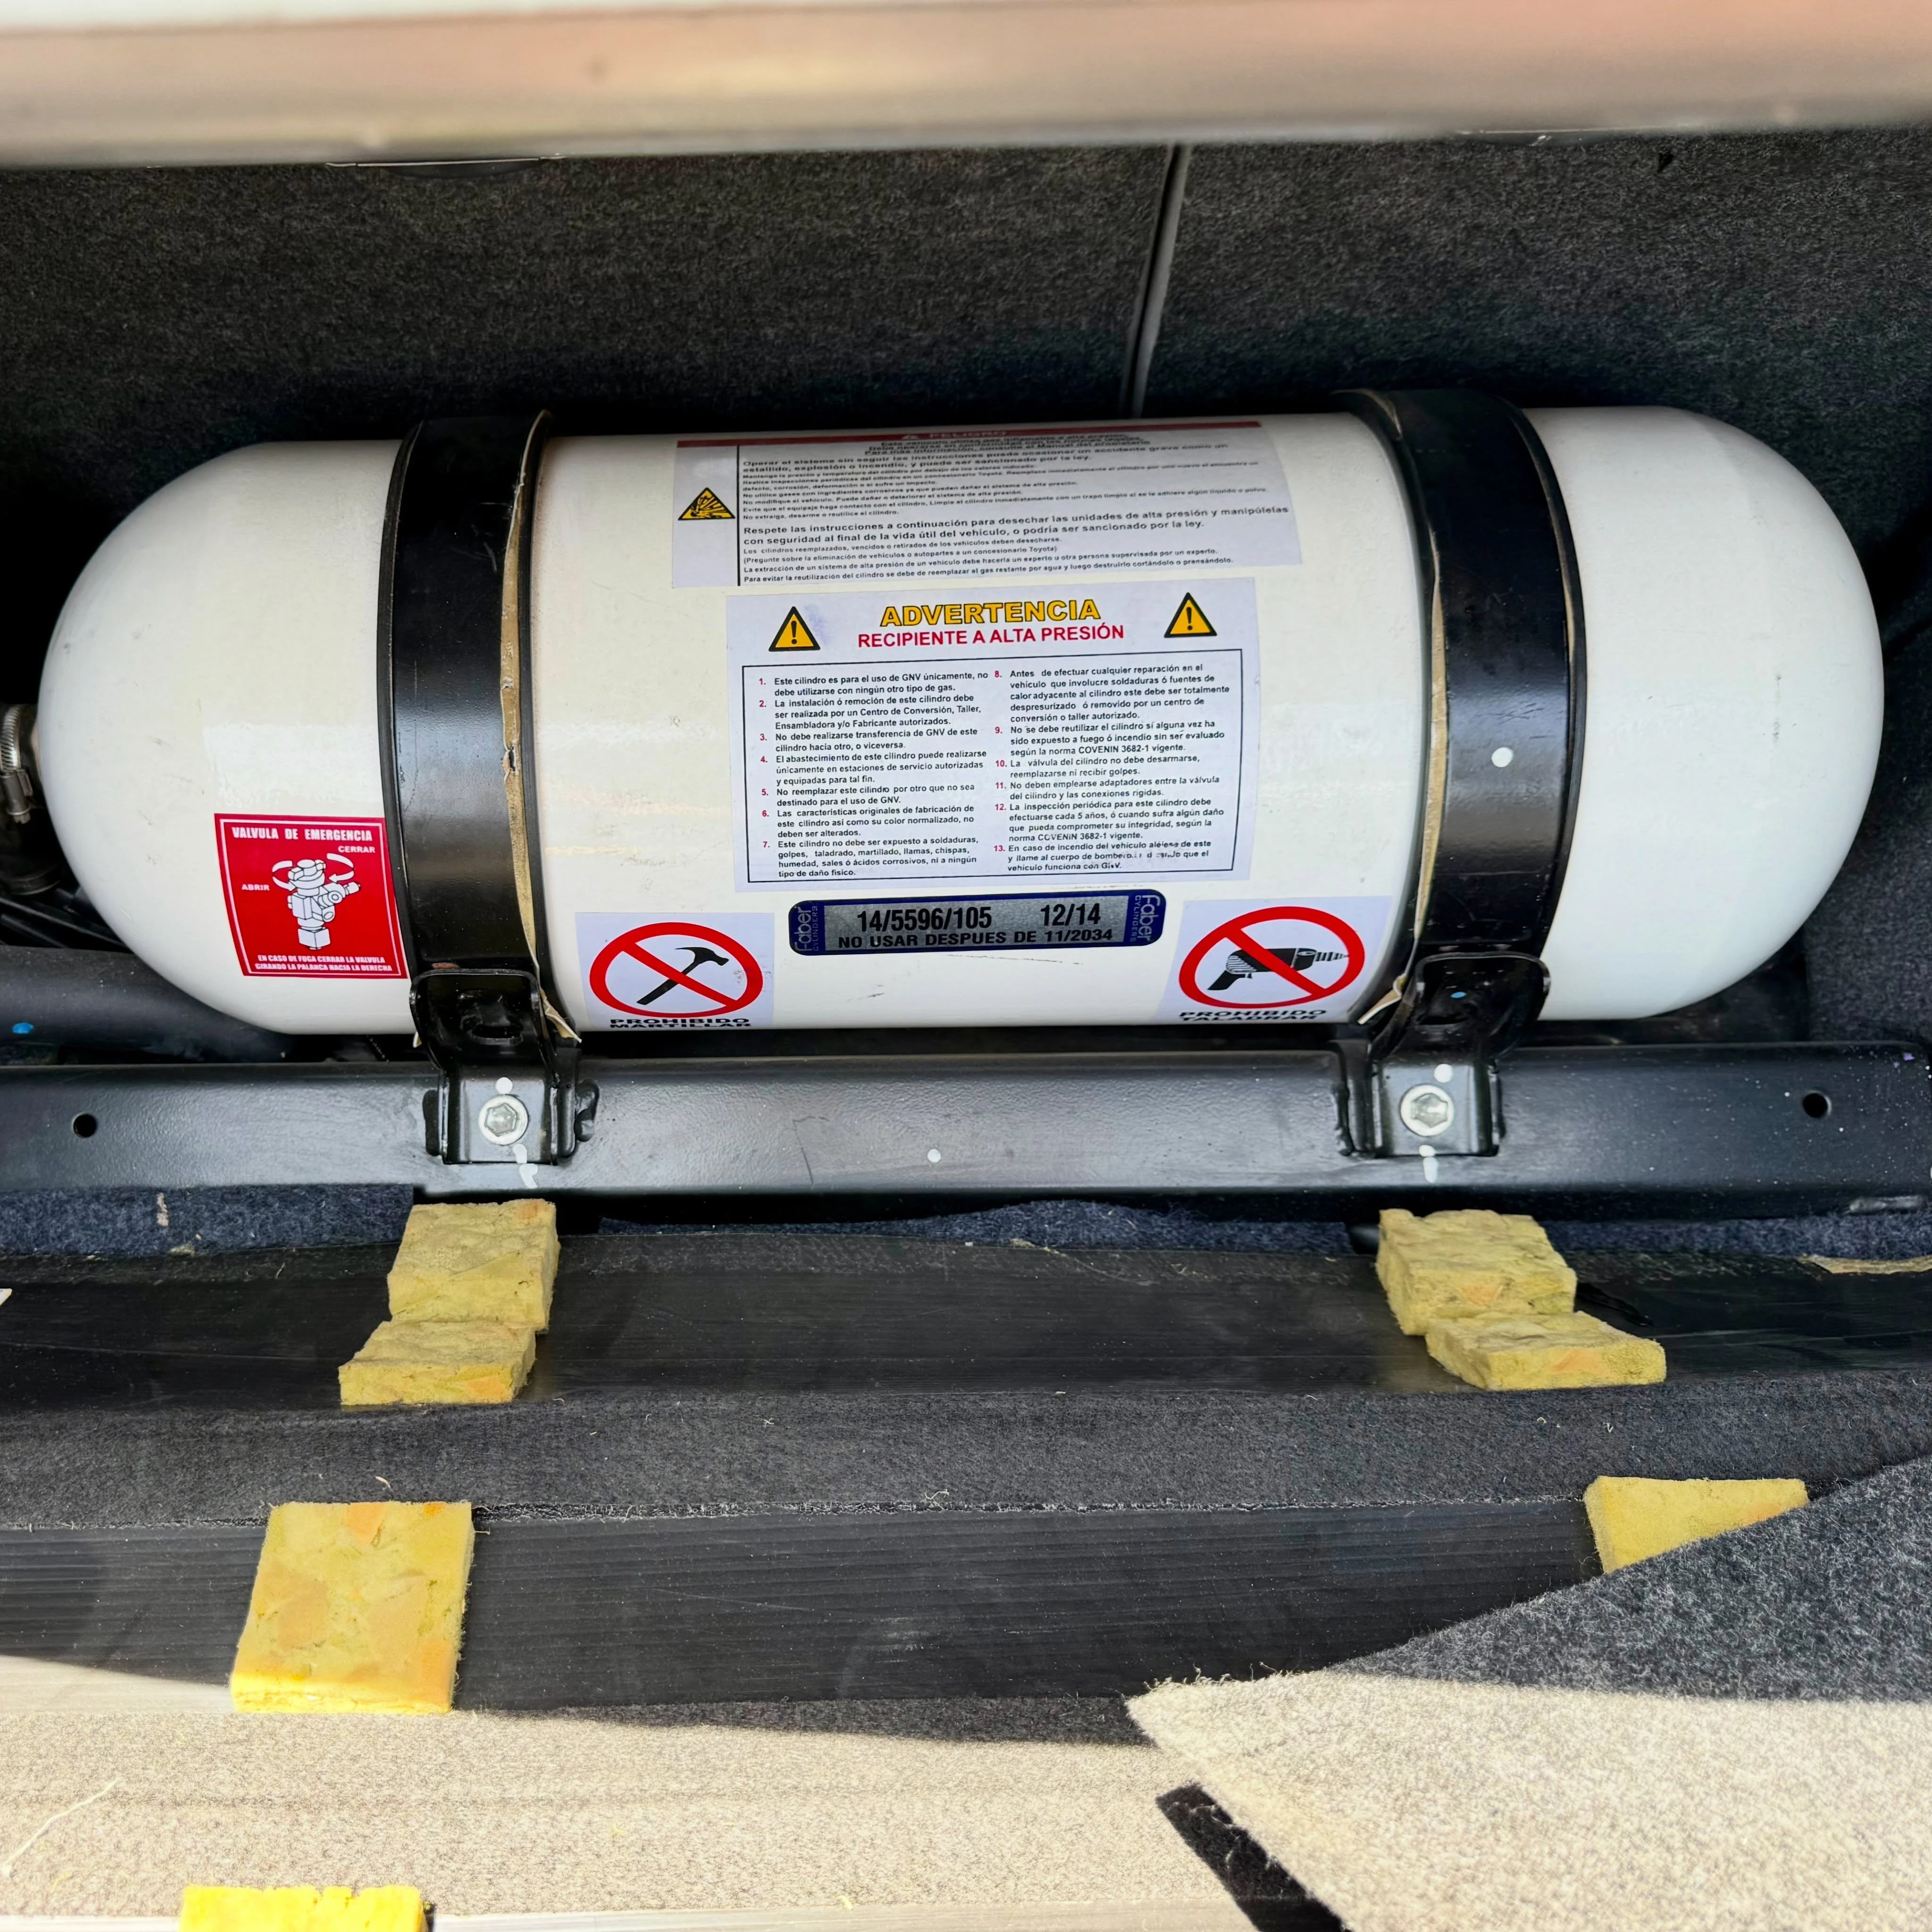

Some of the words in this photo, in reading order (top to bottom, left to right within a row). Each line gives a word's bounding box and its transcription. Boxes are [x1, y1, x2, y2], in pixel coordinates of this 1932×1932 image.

[897, 520, 967, 528] continuación
[1072, 513, 1122, 521] unidades
[1166, 510, 1208, 519] presión
[767, 535, 820, 545] seguridad
[1083, 523, 1147, 531] sancionado
[880, 599, 1101, 627] ADVERTENCIA
[858, 631, 967, 647] RECIPIENTE
[972, 630, 985, 643] A
[990, 628, 1035, 643] ALTA
[1041, 622, 1124, 641] PRESIÓN
[795, 676, 826, 684] cilindro
[841, 677, 859, 685] para
[924, 673, 974, 681] únicamente,
[856, 686, 884, 695] ningún
[907, 685, 922, 694] tipo
[938, 685, 955, 693] gas.
[790, 699, 834, 707] instalación
[845, 697, 883, 705] remoción
[791, 710, 828, 718] realizada
[957, 705, 981, 713] Taller,
[776, 721, 835, 730] Ensambladora
[1054, 781, 1097, 789] emplearse
[1100, 778, 1152, 787] adaptadores
[792, 788, 837, 796] reemplazar
[777, 798, 817, 806] destinado
[881, 796, 900, 804] GNV.
[232, 827, 279, 839] VALVULA
[284, 829, 298, 840] DE
[304, 829, 373, 841] EMERGENCIA
[857, 906, 992, 933] 14/5596/105
[1041, 903, 1101, 926] 12/14
[1136, 895, 1161, 941] Faber
[794, 906, 812, 951] Faber
[838, 936, 862, 949] NO
[869, 934, 918, 948] USAR
[925, 931, 1007, 946] DESPUES
[1014, 931, 1037, 943] DE
[1044, 929, 1113, 942] 11/2034
